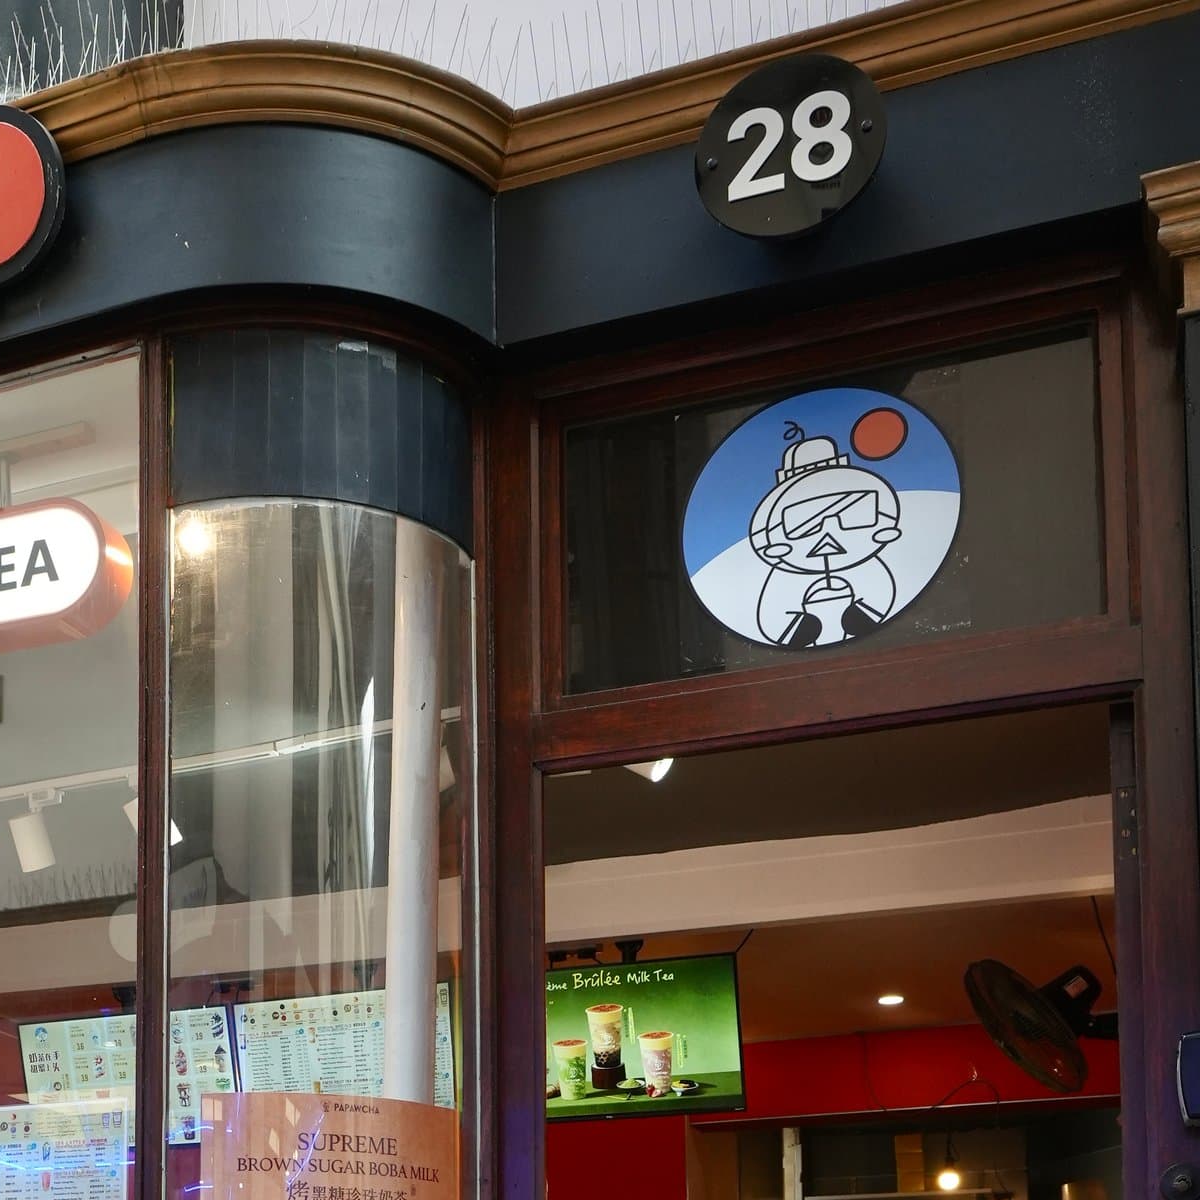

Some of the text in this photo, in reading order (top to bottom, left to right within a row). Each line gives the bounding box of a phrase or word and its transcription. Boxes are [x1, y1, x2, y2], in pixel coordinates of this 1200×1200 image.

[726, 90, 853, 202] 28
[572, 970, 622, 990] Brûlée
[626, 970, 651, 984] Milk
[653, 969, 674, 982] Tea
[333, 1102, 380, 1114] PAPAWCHA
[297, 1132, 399, 1156] SUPREME
[236, 1156, 440, 1183] BROWN SUGAR BOBA MILK
